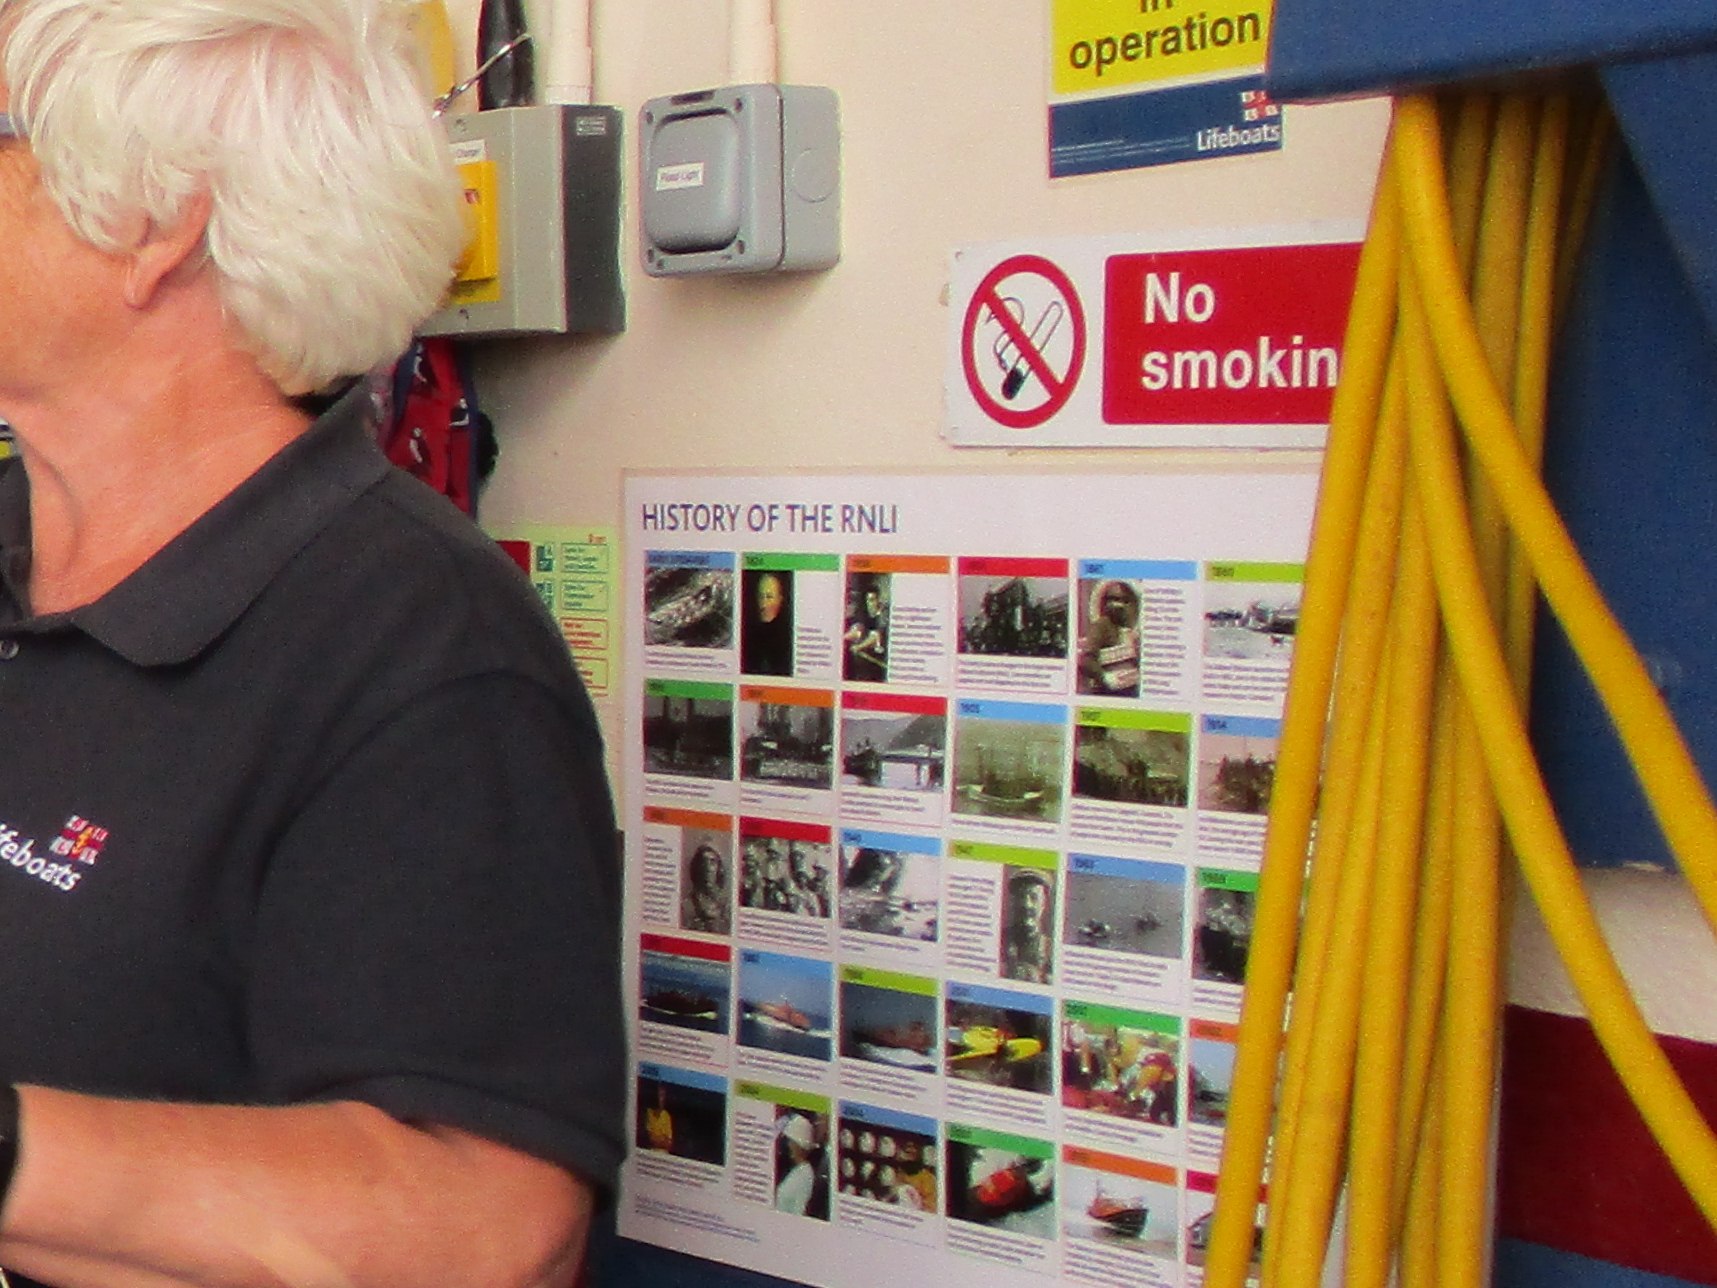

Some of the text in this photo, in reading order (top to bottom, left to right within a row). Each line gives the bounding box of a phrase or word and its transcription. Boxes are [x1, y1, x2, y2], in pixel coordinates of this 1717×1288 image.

[1069, 10, 1261, 77] operation
[1196, 123, 1281, 152] Lifeboats
[1143, 272, 1216, 324] No
[1140, 335, 1339, 390] smokin
[641, 502, 898, 534] HISTORY OF THE RNLI
